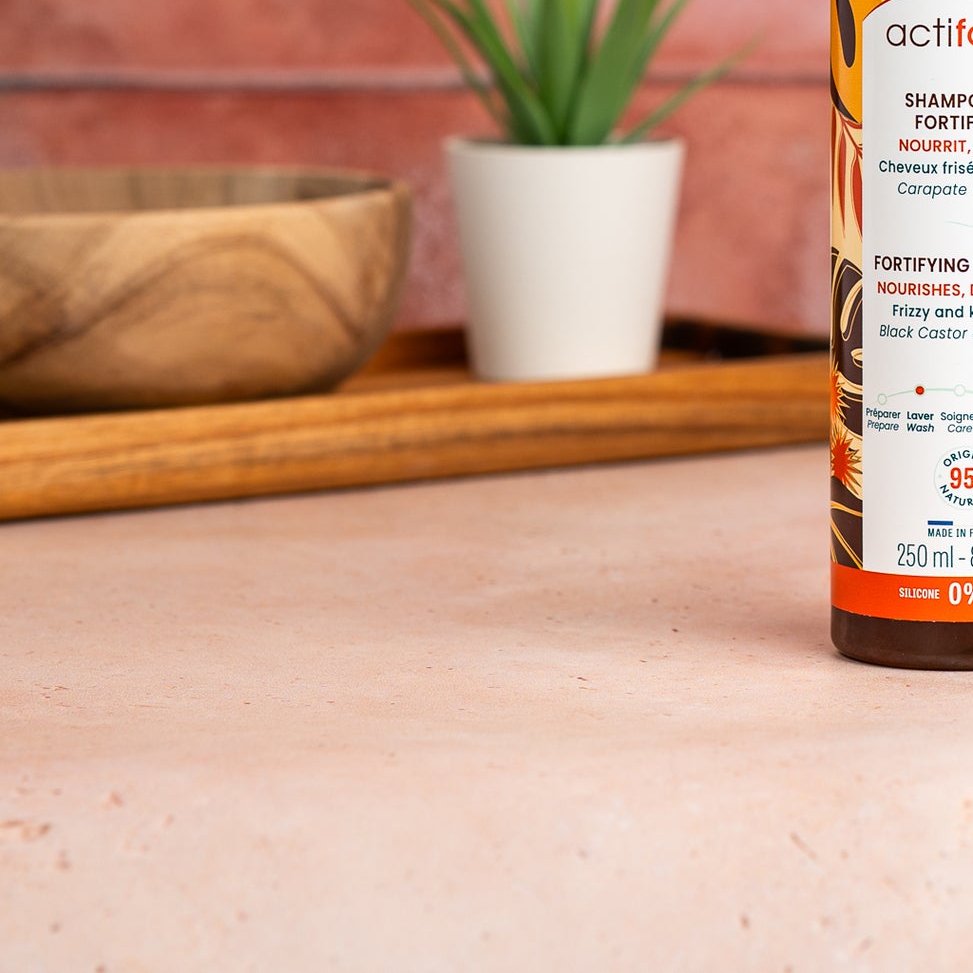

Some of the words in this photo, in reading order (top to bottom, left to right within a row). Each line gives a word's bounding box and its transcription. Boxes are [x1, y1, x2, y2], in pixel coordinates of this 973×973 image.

[898, 138, 971, 154] NOURRIT,
[878, 160, 938, 174] Cheveux
[897, 181, 967, 199] Carapate
[874, 255, 970, 273] FORTIFYING
[877, 281, 965, 299] NOURISHES,
[892, 304, 930, 322] Frizzy
[935, 304, 964, 319] and
[879, 324, 913, 339] Black
[917, 326, 968, 340] Castor
[865, 407, 901, 421] Préparer
[906, 411, 934, 421] Laver
[867, 420, 900, 432] Prepare
[906, 423, 935, 433] Wash
[947, 424, 973, 433] Care
[927, 528, 953, 537] MADE
[956, 529, 966, 537] IN
[897, 543, 928, 567] 250
[933, 545, 954, 568] ml
[899, 587, 940, 599] SILICONE
